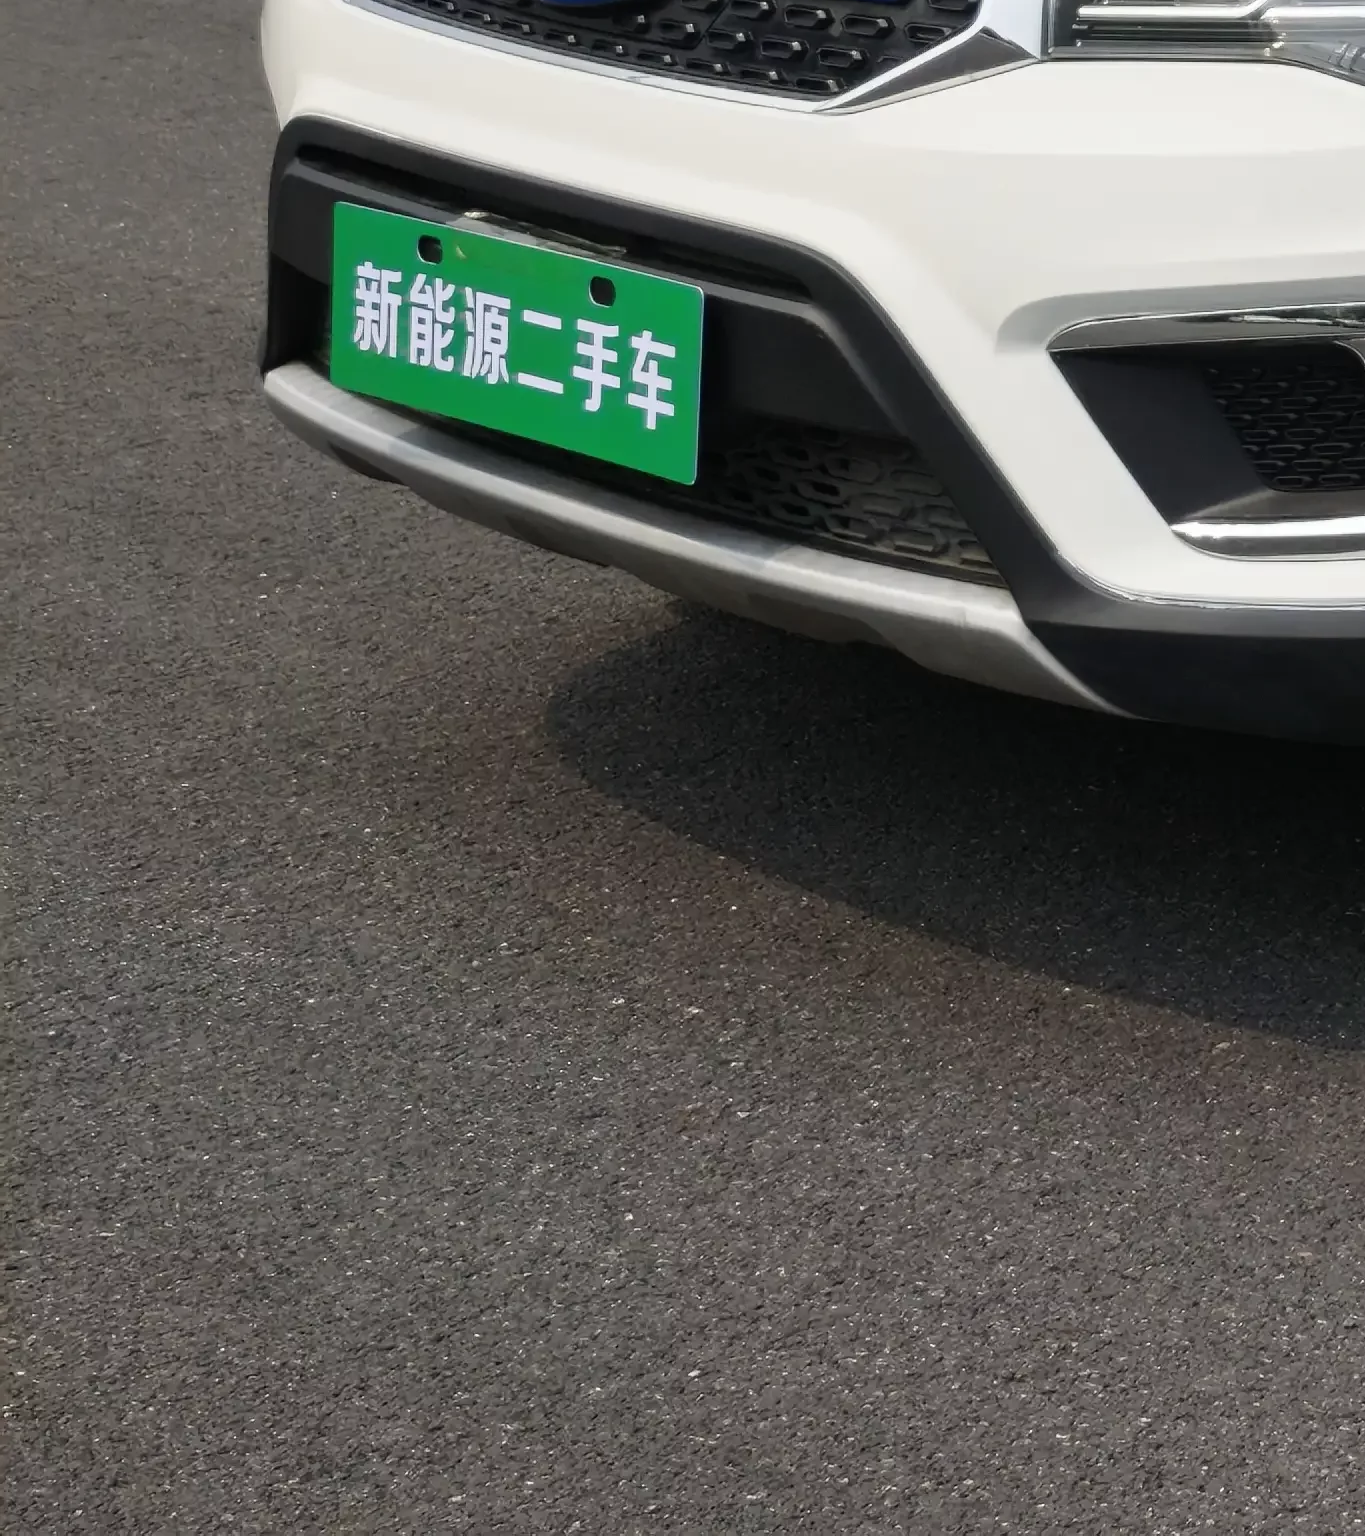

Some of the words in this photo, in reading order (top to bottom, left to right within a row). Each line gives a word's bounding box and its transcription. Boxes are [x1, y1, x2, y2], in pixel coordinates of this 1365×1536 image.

[353, 261, 676, 430] 新能源二手车
